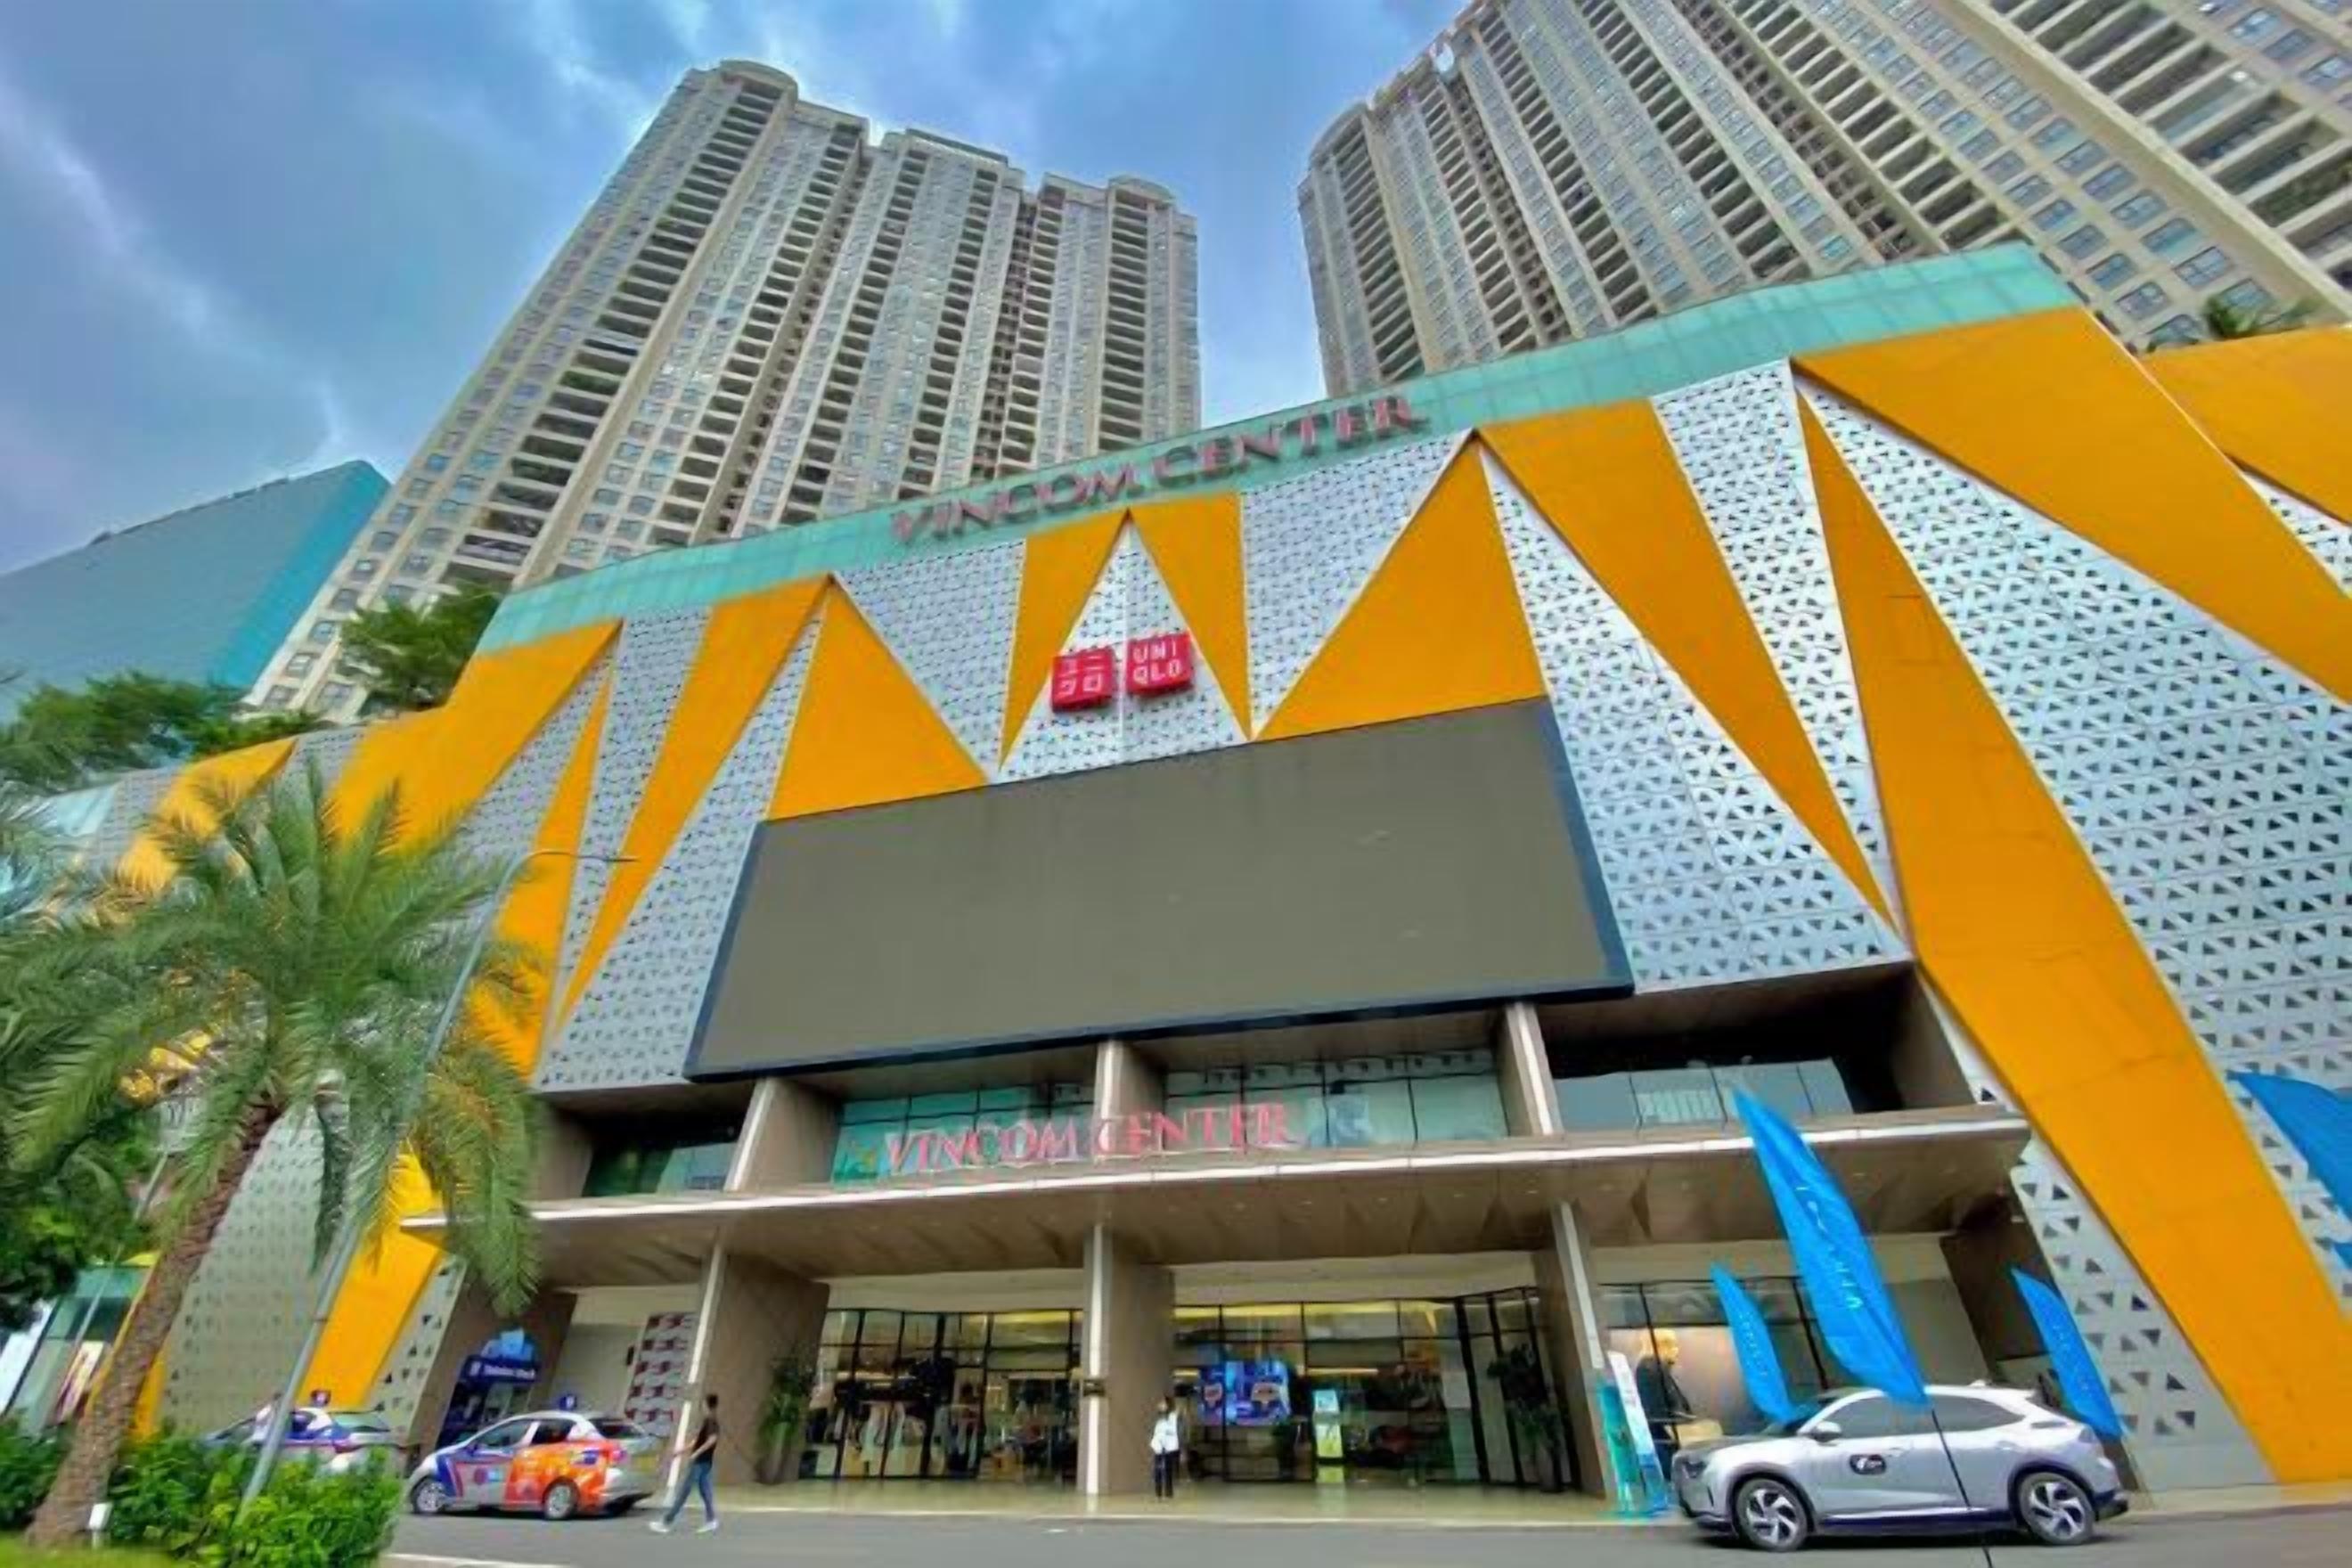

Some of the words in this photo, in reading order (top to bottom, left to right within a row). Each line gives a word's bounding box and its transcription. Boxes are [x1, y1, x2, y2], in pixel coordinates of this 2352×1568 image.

[893, 461, 1146, 542] VINCOM
[1150, 396, 1429, 486] CENTER
[1132, 640, 1178, 664] UNI
[1132, 658, 1181, 685] QLO
[885, 1116, 1082, 1172] VINCOM
[1092, 1102, 1295, 1160] CENTER
